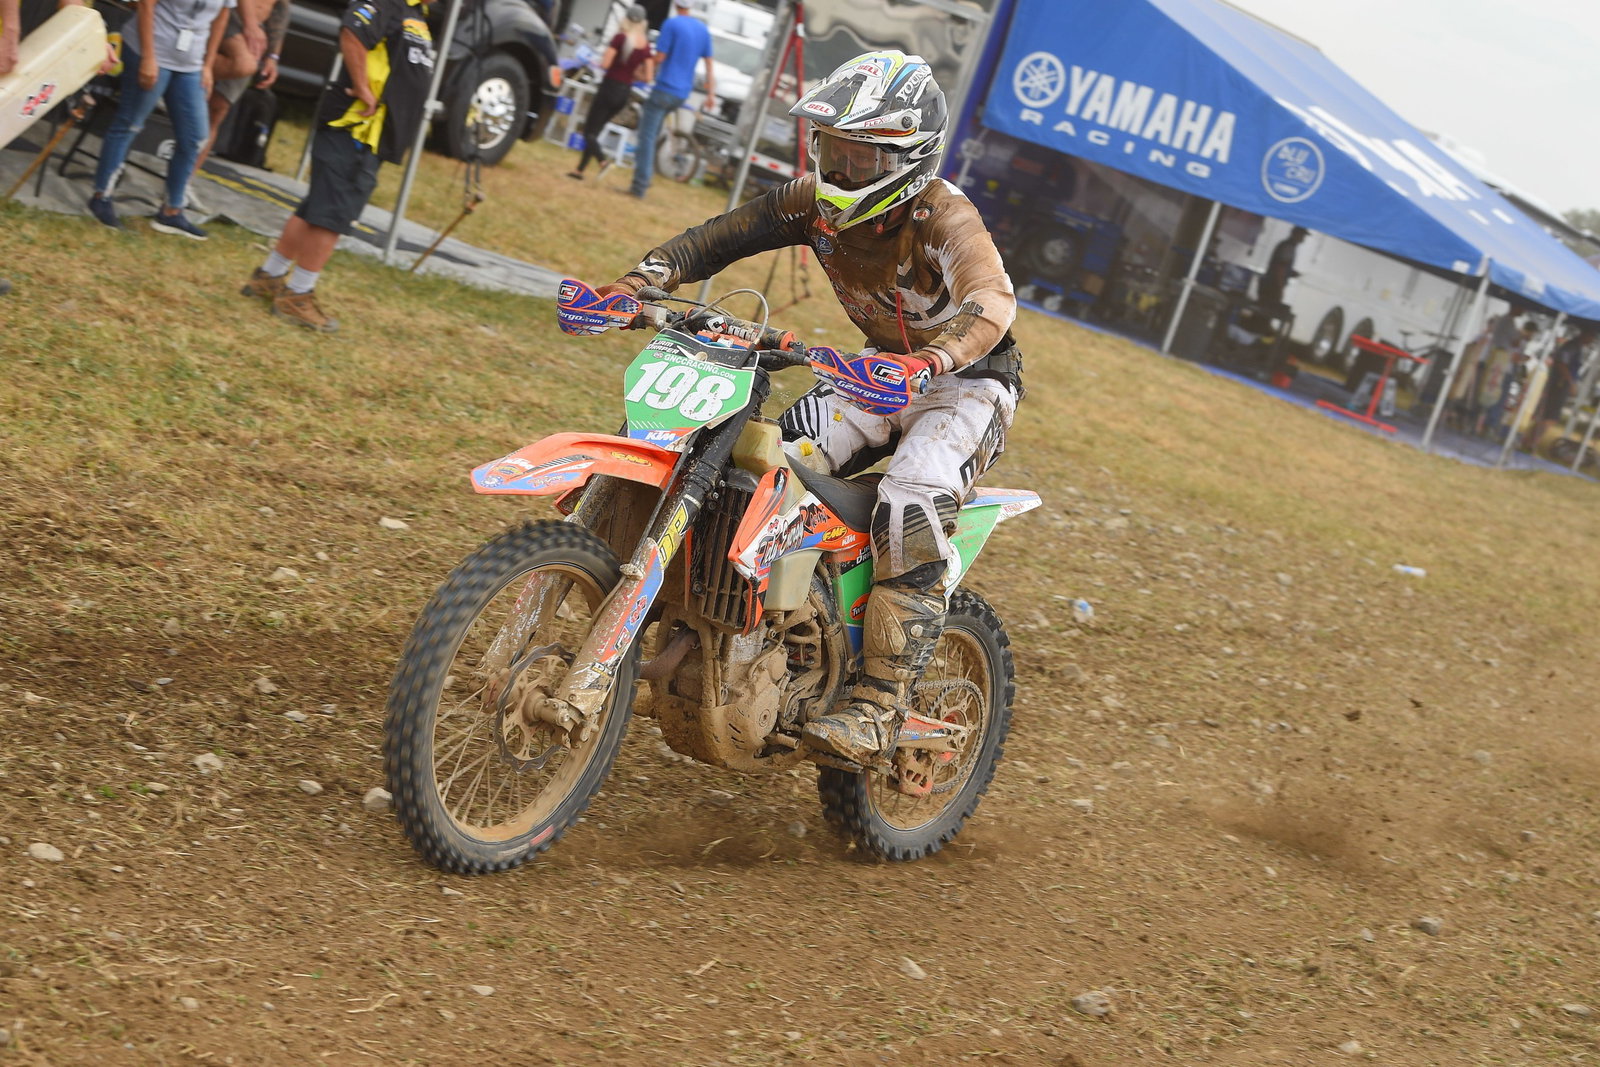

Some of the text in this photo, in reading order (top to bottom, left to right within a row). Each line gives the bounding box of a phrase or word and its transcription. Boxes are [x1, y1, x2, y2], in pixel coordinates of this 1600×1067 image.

[857, 64, 879, 76] BELL
[807, 103, 831, 114] BELL
[1065, 66, 1236, 164] YAMAHA
[1019, 108, 1211, 179] RACING
[664, 354, 737, 380] GNCCRACING.COM
[625, 361, 736, 421] 198
[837, 380, 905, 403] G2ergo.com
[645, 430, 676, 440] KTM
[822, 525, 846, 541] FMF
[842, 535, 856, 546] KTM
